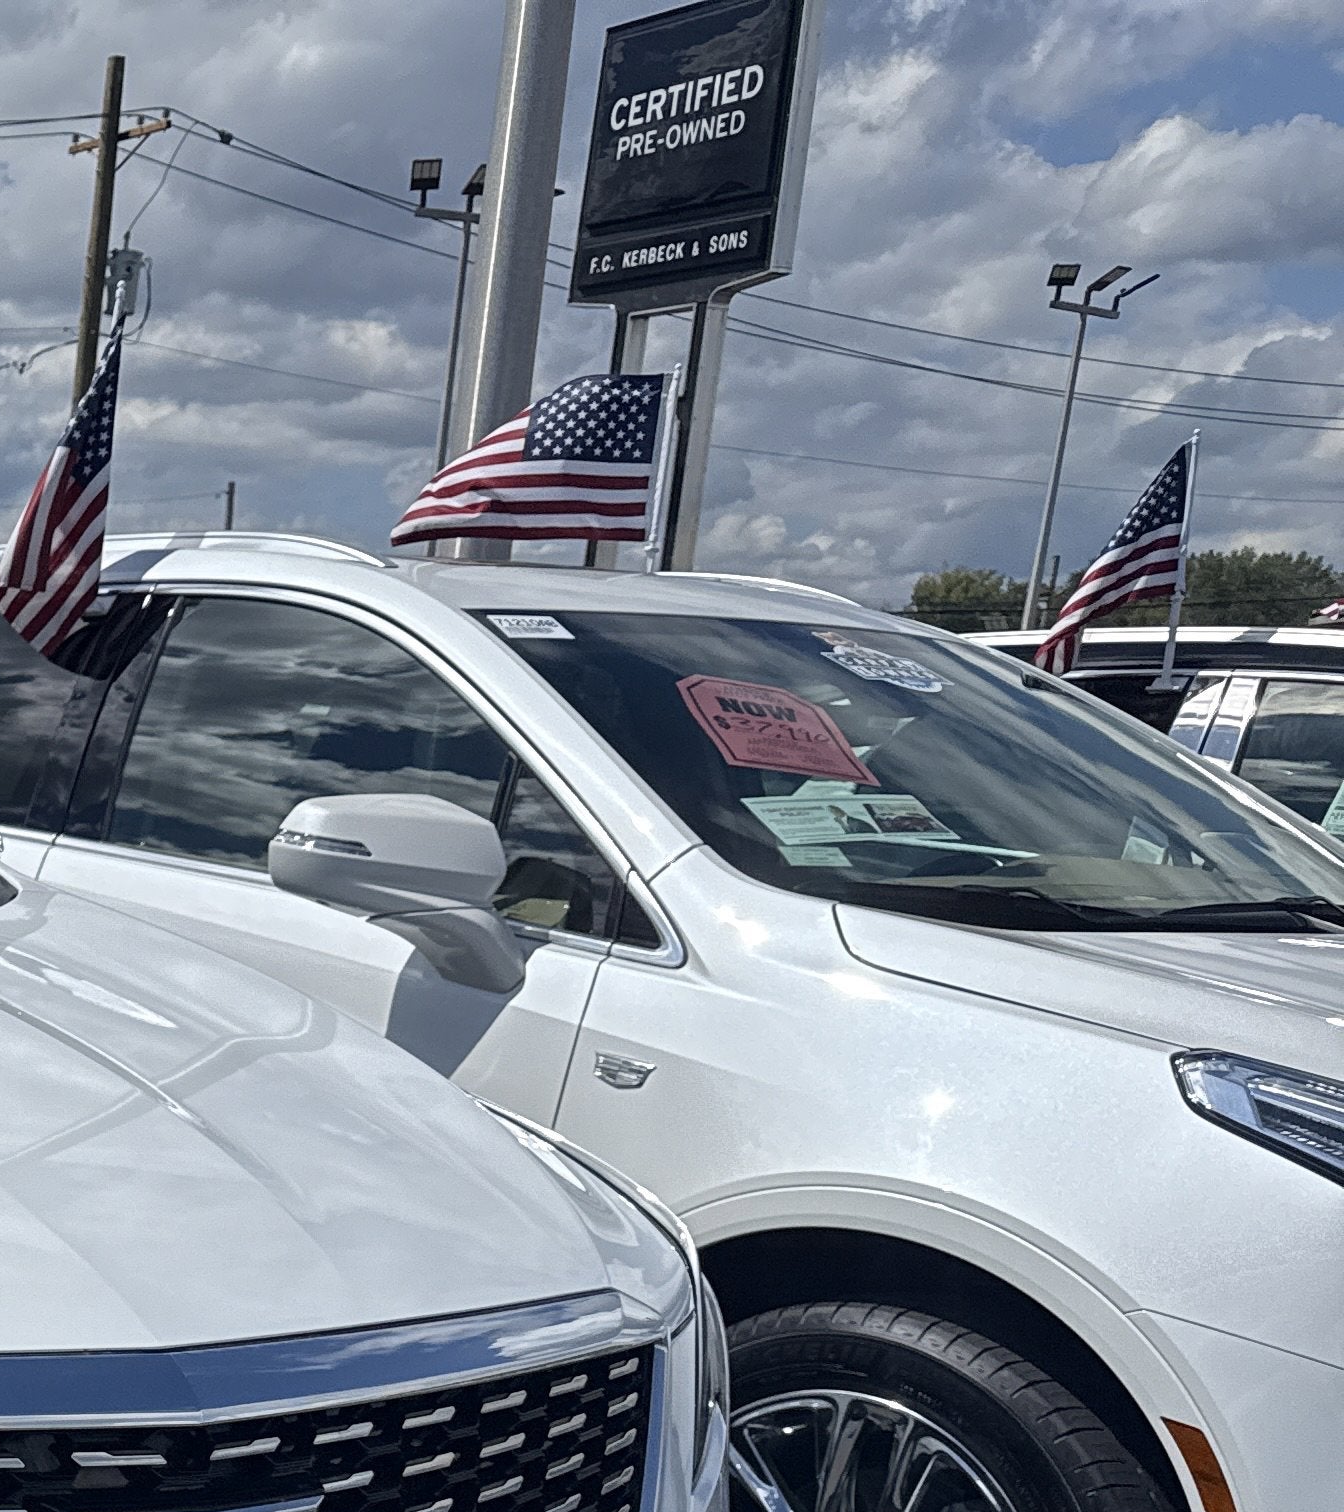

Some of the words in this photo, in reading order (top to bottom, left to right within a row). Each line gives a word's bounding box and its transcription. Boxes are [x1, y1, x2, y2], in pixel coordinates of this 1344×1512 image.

[610, 64, 765, 131] CERTIFIED
[616, 109, 746, 161] PRE-OWNED
[589, 254, 615, 274] F.C.
[621, 241, 686, 269] KERBECK
[691, 240, 700, 257] &
[708, 230, 749, 254] SONS
[715, 696, 797, 723] NOW
